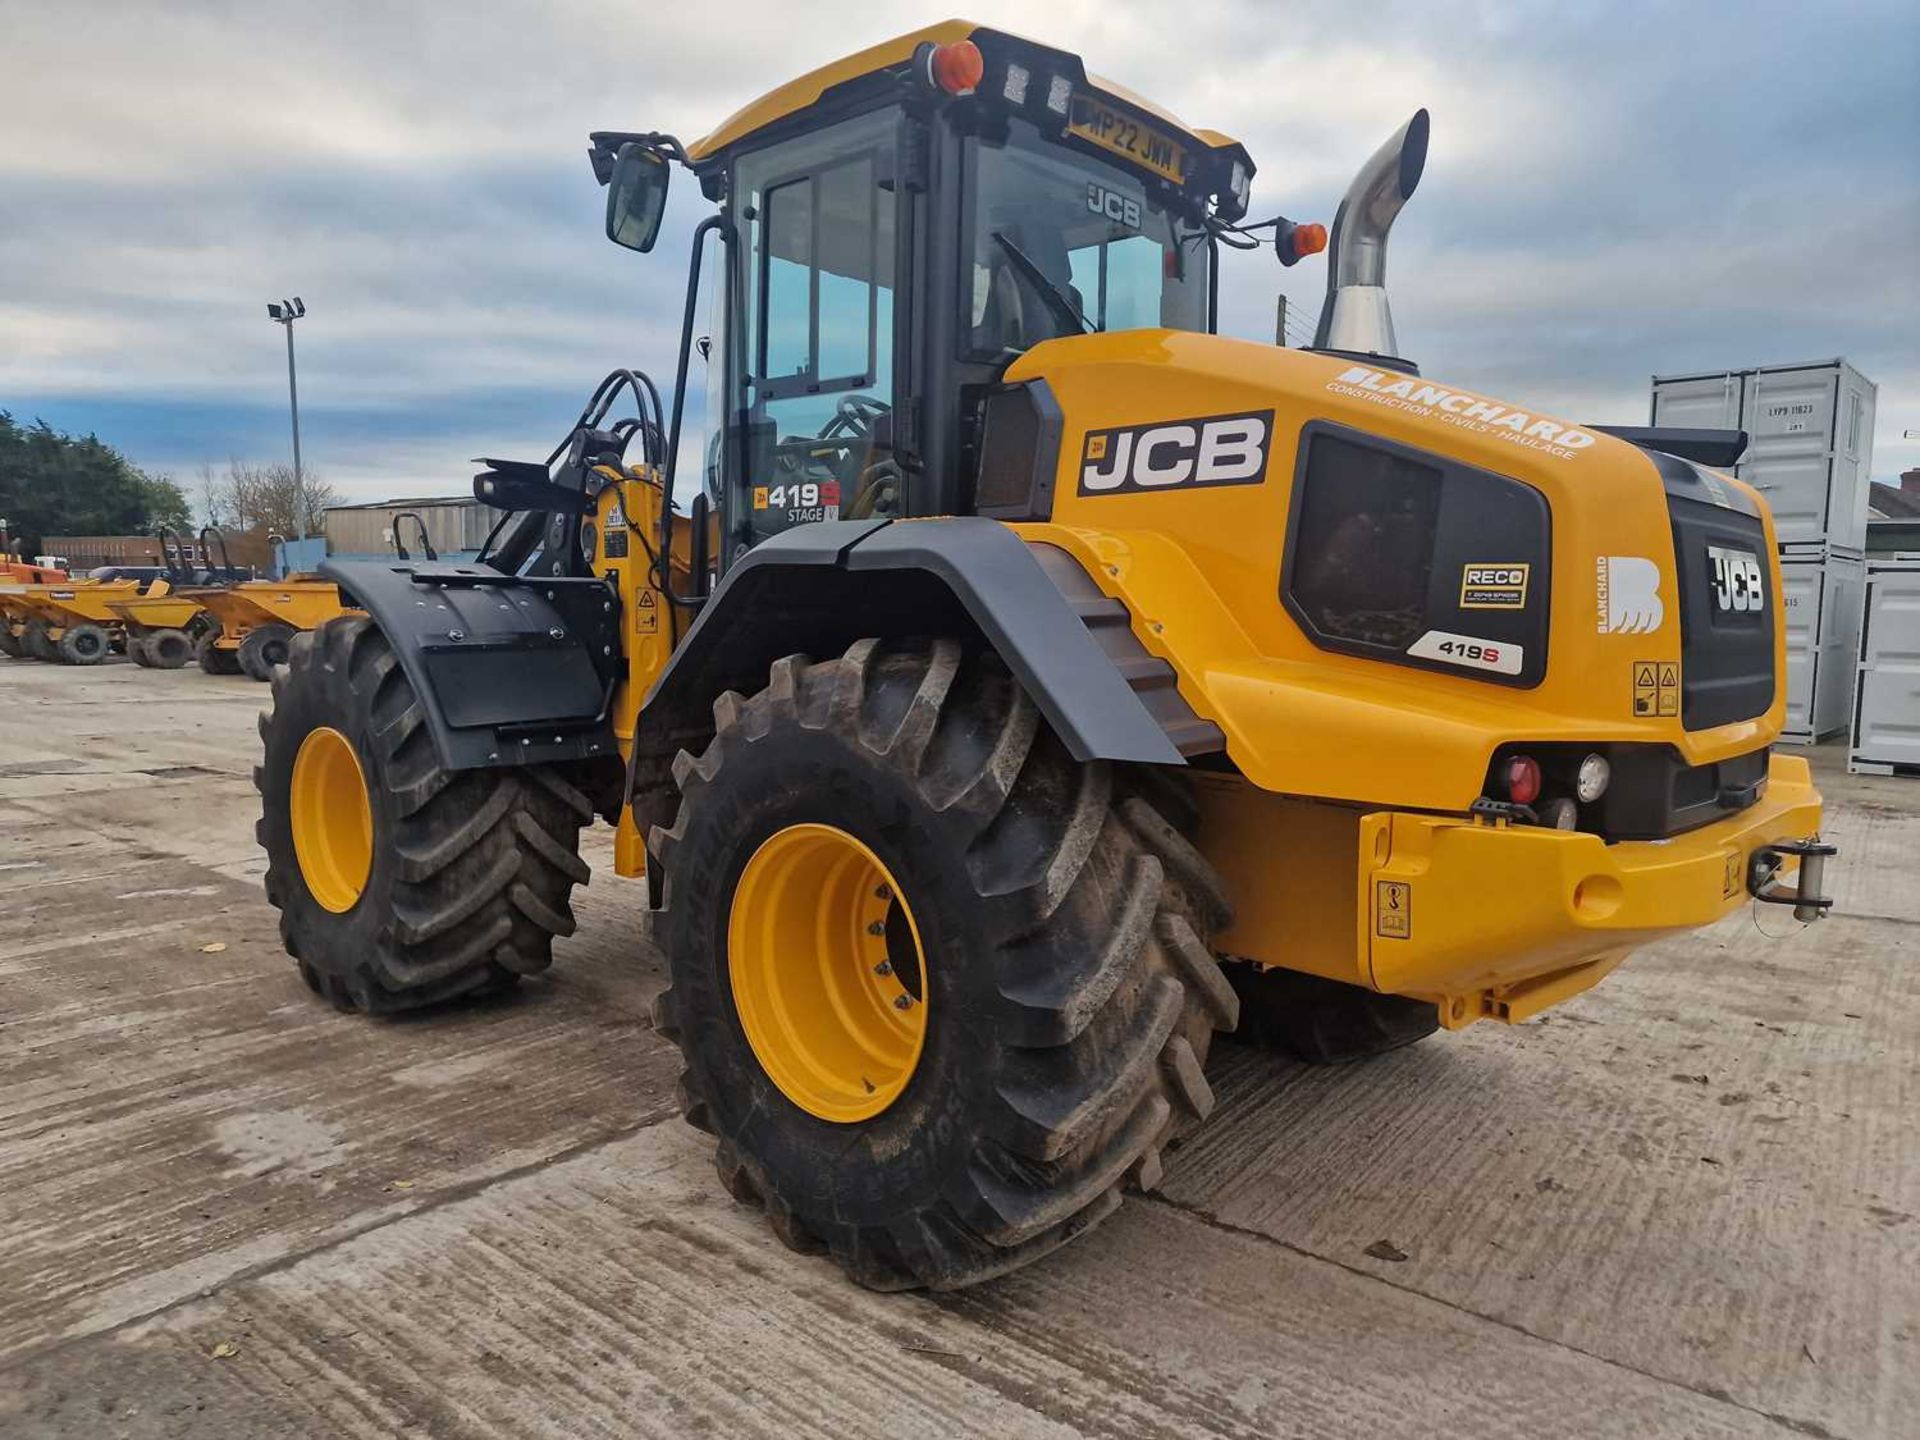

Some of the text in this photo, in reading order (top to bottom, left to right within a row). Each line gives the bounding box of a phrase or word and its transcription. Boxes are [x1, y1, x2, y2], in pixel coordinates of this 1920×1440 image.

[1088, 183, 1141, 229] JCB
[1326, 382, 1577, 461] CONSTRUCTION CIVILS HAULAGE
[1336, 367, 1596, 449] BLANCHARD
[1084, 418, 1266, 490] JCB
[788, 508, 823, 522] STAGE
[1467, 570, 1523, 585] RECO
[1597, 556, 1608, 634] BLANCHARD
[1709, 546, 1763, 611] JCB
[1439, 641, 1500, 663] 419S
